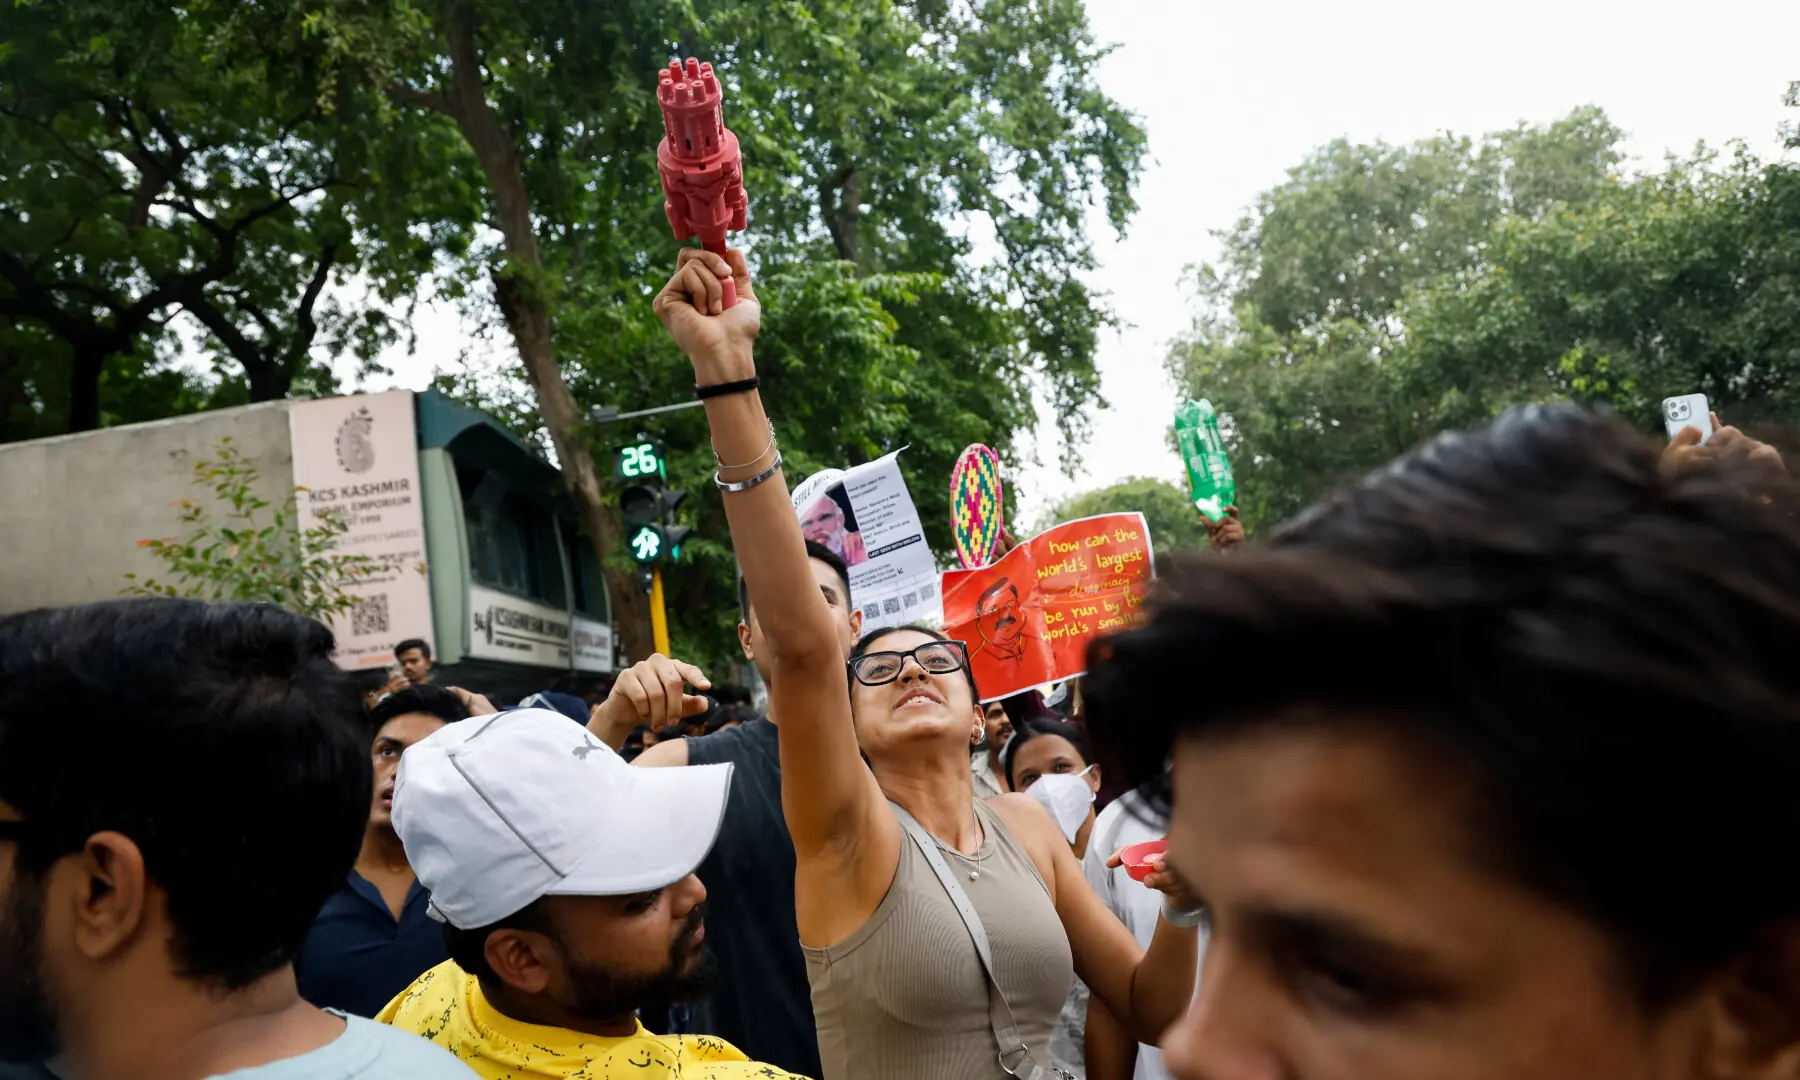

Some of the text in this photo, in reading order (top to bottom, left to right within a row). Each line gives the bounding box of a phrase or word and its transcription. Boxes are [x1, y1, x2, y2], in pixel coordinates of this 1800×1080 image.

[622, 444, 657, 476] 26
[309, 479, 410, 502] KCS KASHMIR
[352, 497, 411, 511] EMPORIUM
[1048, 528, 1139, 555] how can the
[1037, 548, 1143, 579] world's largest
[1070, 579, 1129, 598] democracy
[1044, 610, 1064, 624] be
[1071, 605, 1098, 619] run
[1103, 599, 1120, 616] by
[1040, 621, 1089, 641] world's
